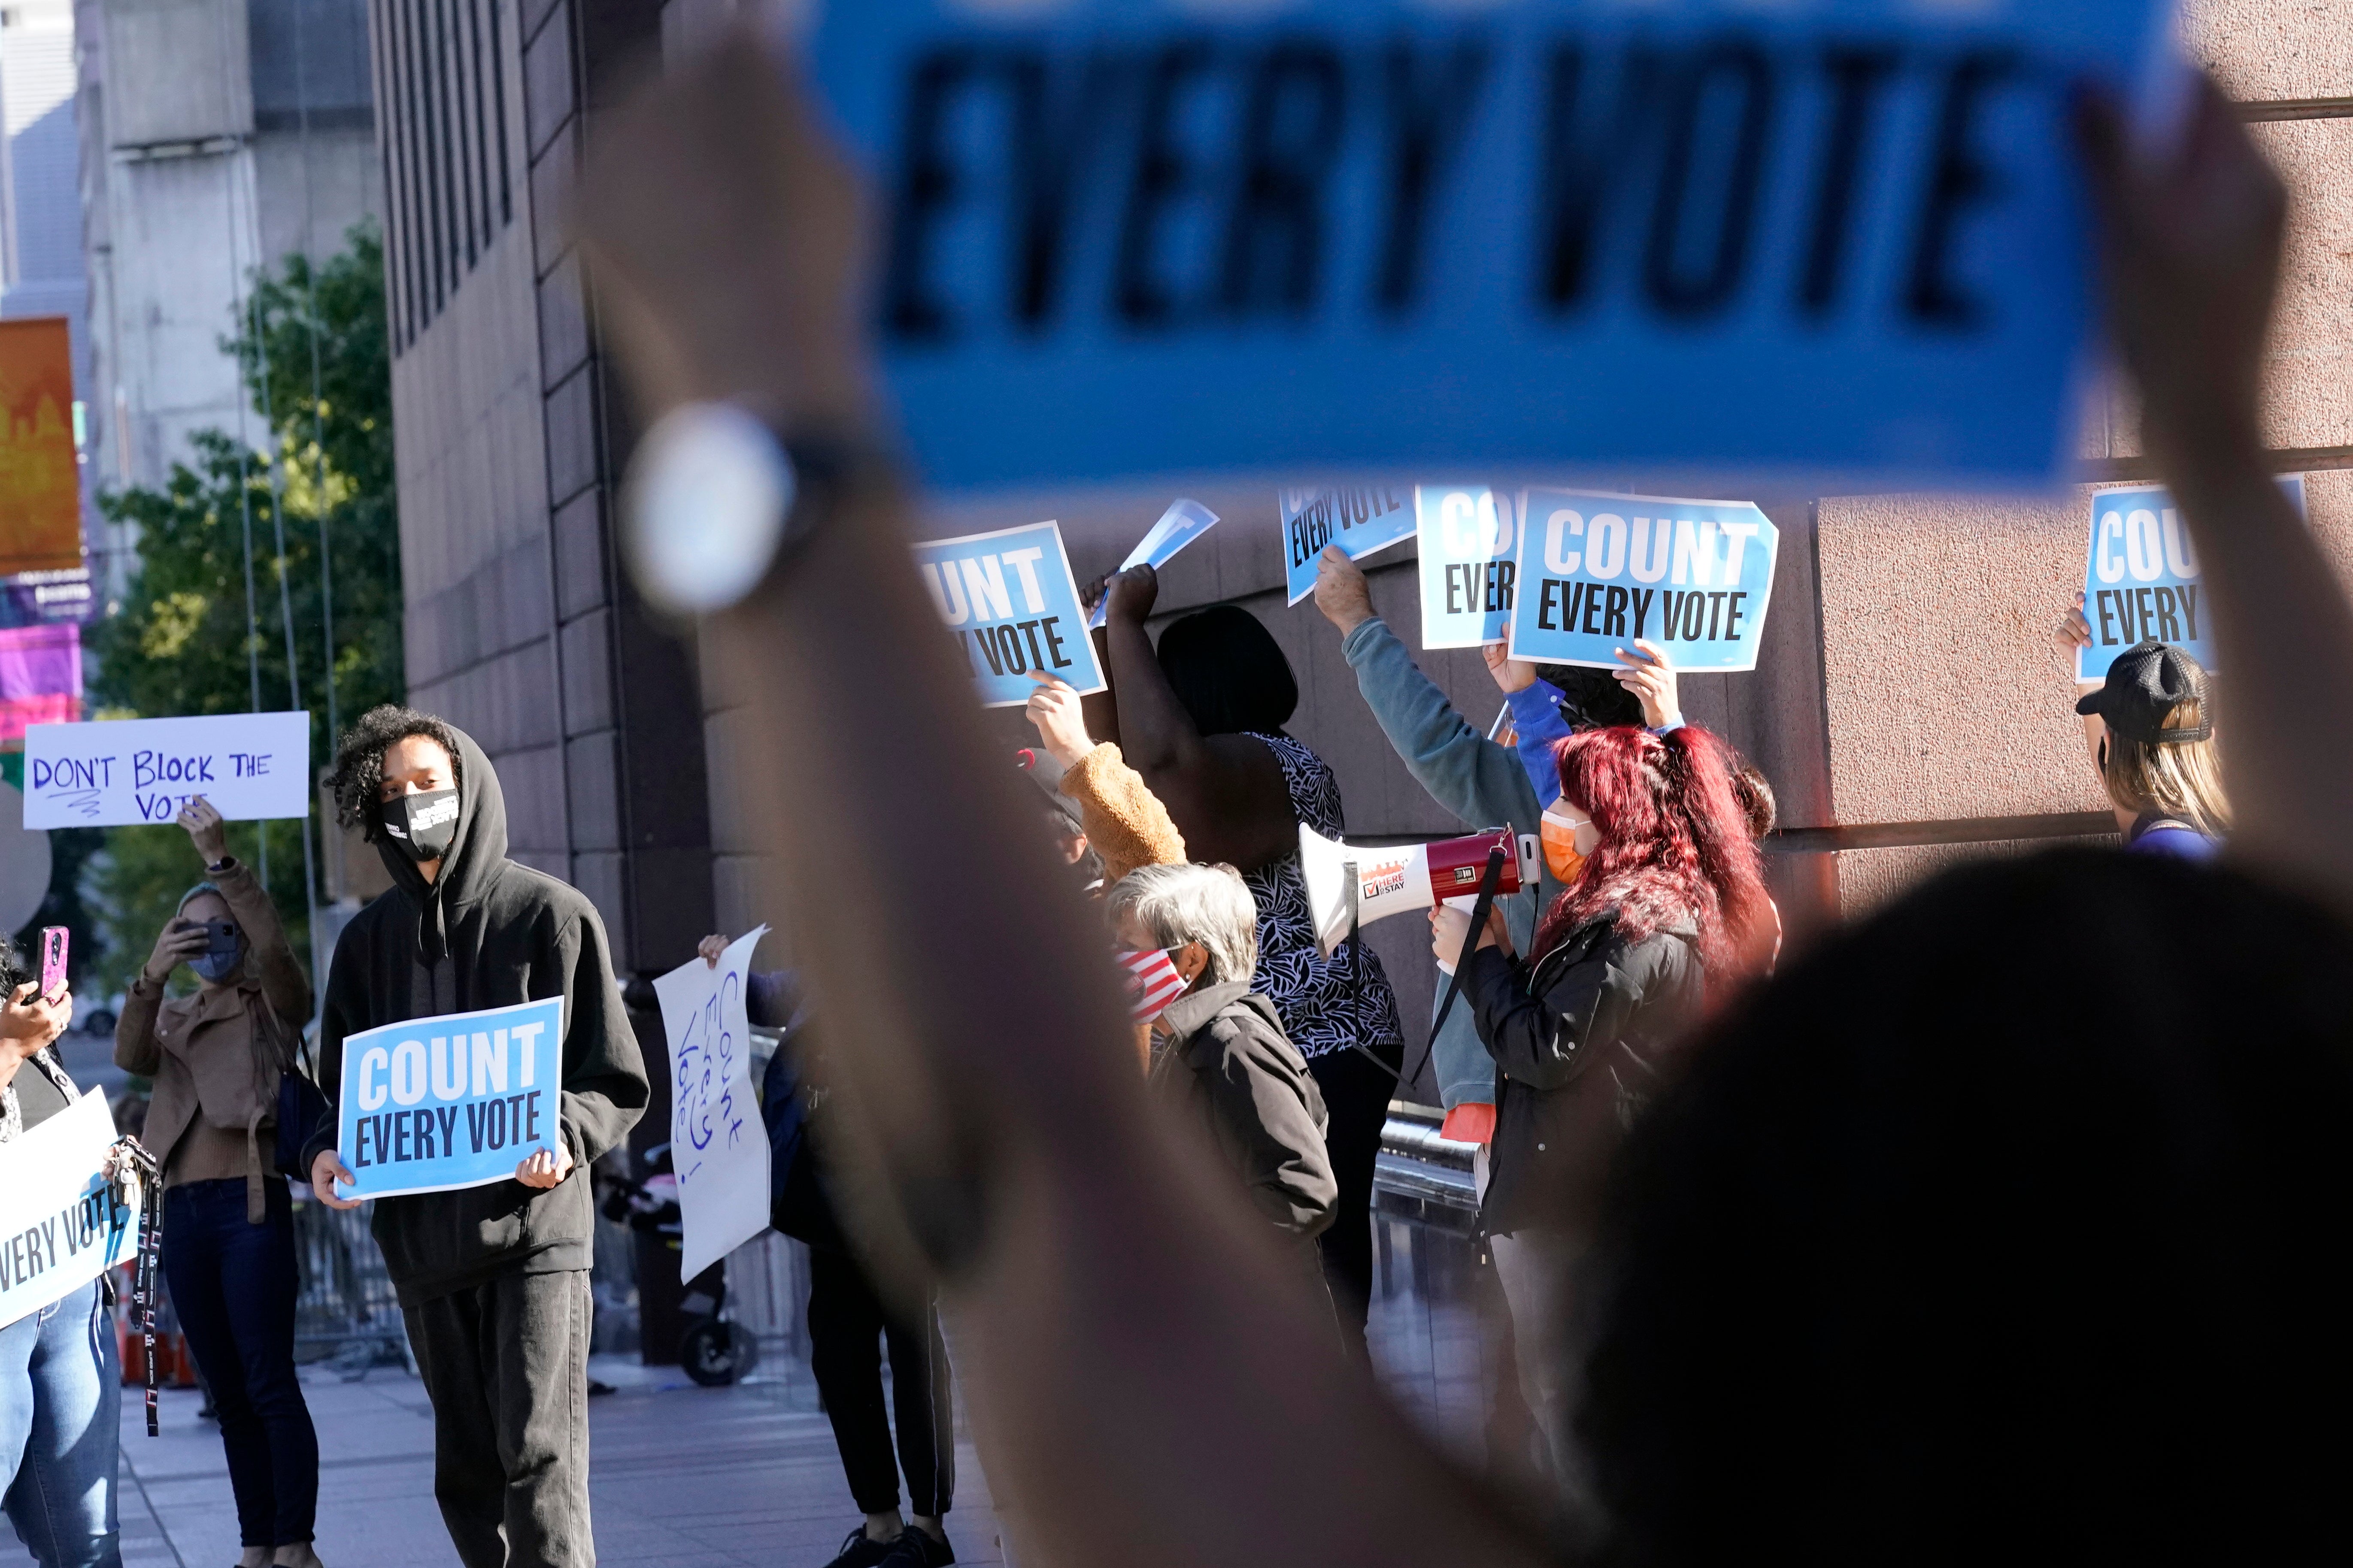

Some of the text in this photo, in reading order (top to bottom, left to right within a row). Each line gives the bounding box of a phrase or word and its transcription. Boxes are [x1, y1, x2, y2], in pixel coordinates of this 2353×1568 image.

[884, 36, 2015, 341] EVERY VOTE
[1292, 493, 1333, 569] EVERY
[1441, 492, 1518, 557] CO
[1544, 509, 1758, 585] COUNT
[2096, 509, 2201, 584] COU
[922, 546, 1046, 625] UNT
[1445, 561, 1516, 614] EVER
[1538, 578, 1747, 641] EVERY VOTE
[2097, 584, 2197, 646] EVERY
[974, 616, 1072, 676] VOTE
[33, 750, 273, 790] DON'T BLOCK THE
[1379, 872, 1404, 888] HERE
[1385, 881, 1404, 894] STAY
[358, 1021, 545, 1111] COUNT
[718, 971, 743, 1150] Count
[355, 1090, 540, 1168] EVERY VOTE
[0, 1184, 124, 1293] VERY VOTE
